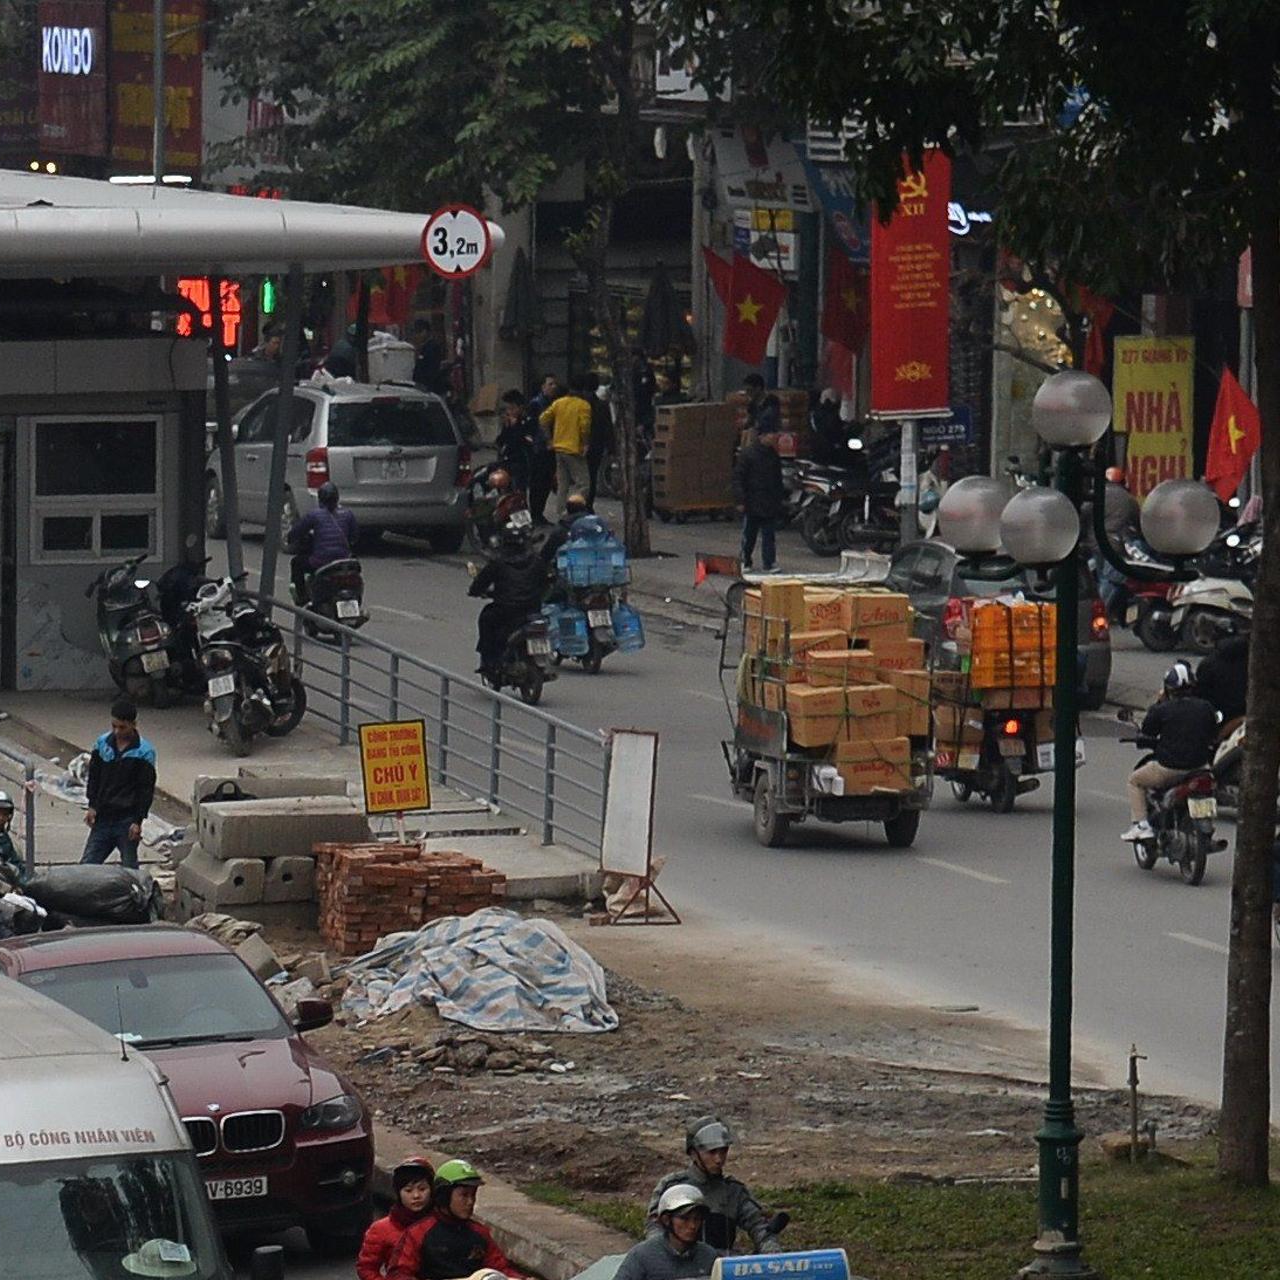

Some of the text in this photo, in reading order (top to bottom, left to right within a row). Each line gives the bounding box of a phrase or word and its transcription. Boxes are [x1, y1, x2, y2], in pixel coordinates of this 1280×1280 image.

[432, 226, 479, 259] 3,2m
[1125, 382, 1183, 433] NHÀ
[373, 760, 418, 785] CHÚ Ý
[3, 1129, 27, 1153] BỘ
[28, 1126, 73, 1149] CÔNG
[74, 1124, 119, 1147] NHÂN
[120, 1122, 157, 1145] VIÊN
[770, 1257, 810, 1278] SAO
